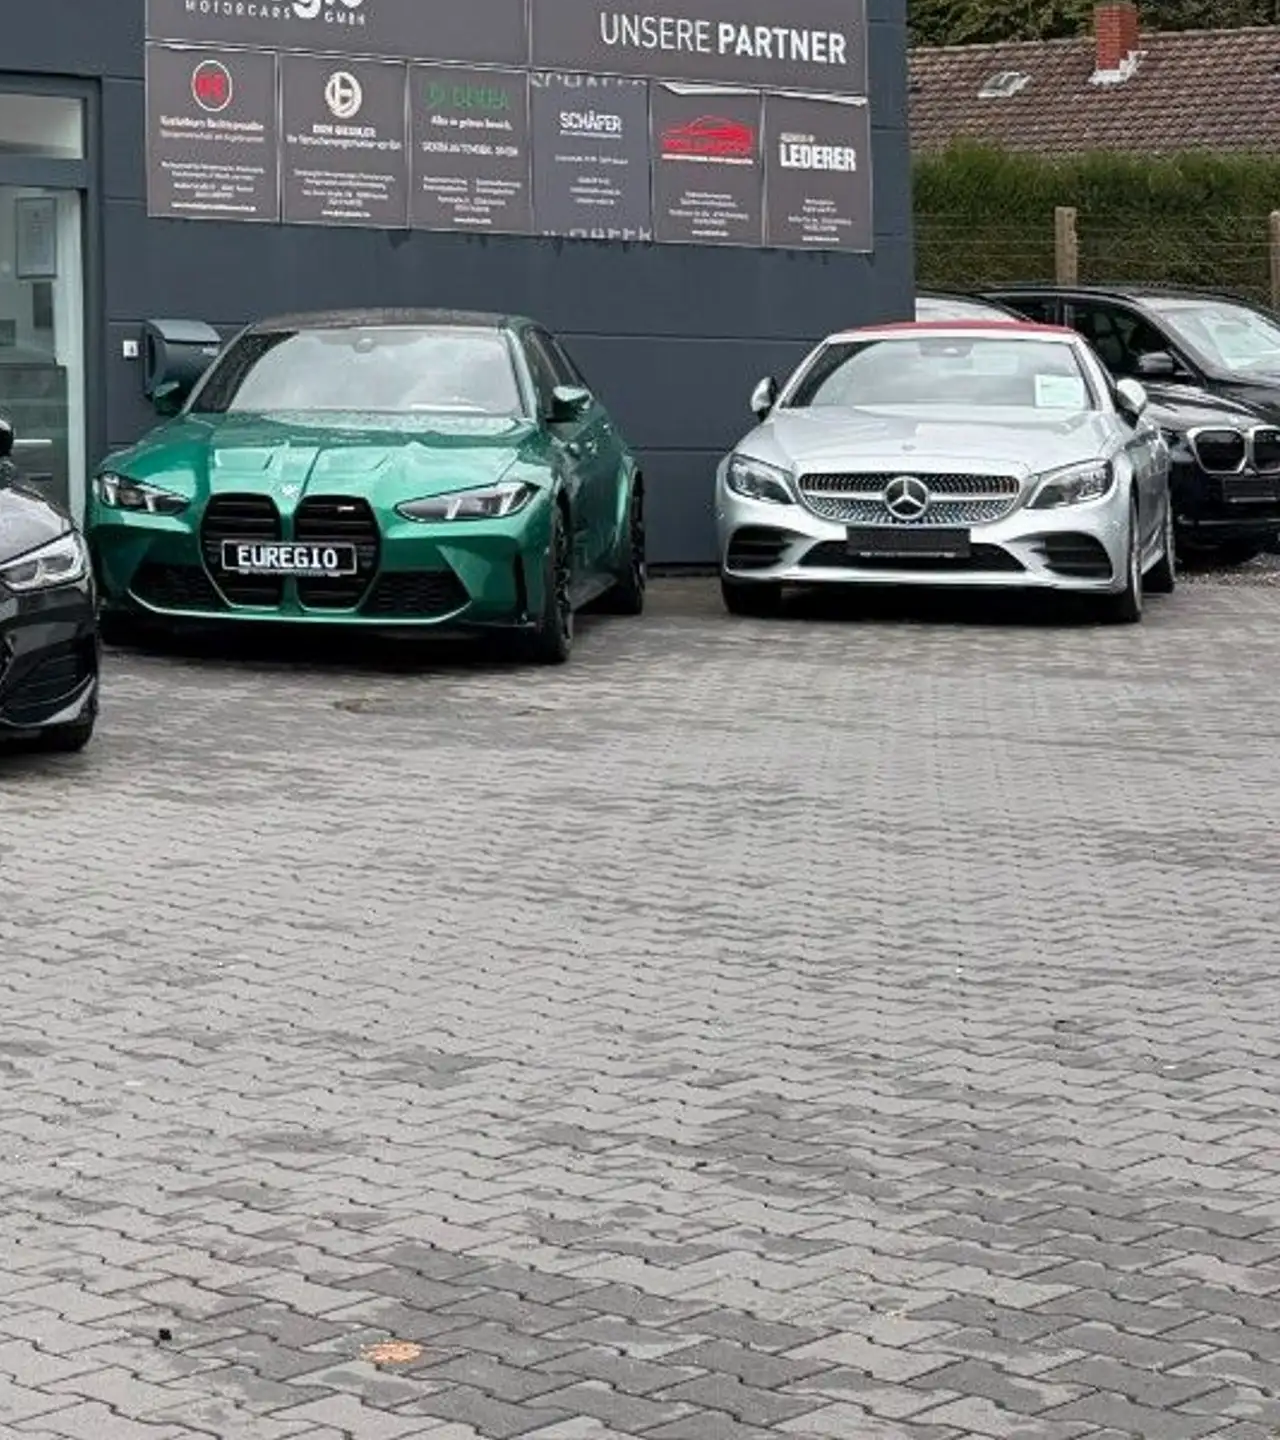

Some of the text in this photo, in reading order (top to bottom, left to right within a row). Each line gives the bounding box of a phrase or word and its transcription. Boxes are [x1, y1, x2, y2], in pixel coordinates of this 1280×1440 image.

[600, 12, 846, 64] UNSERE PARTNER
[780, 143, 856, 172] LEDERER
[237, 545, 338, 569] EUREGIO
